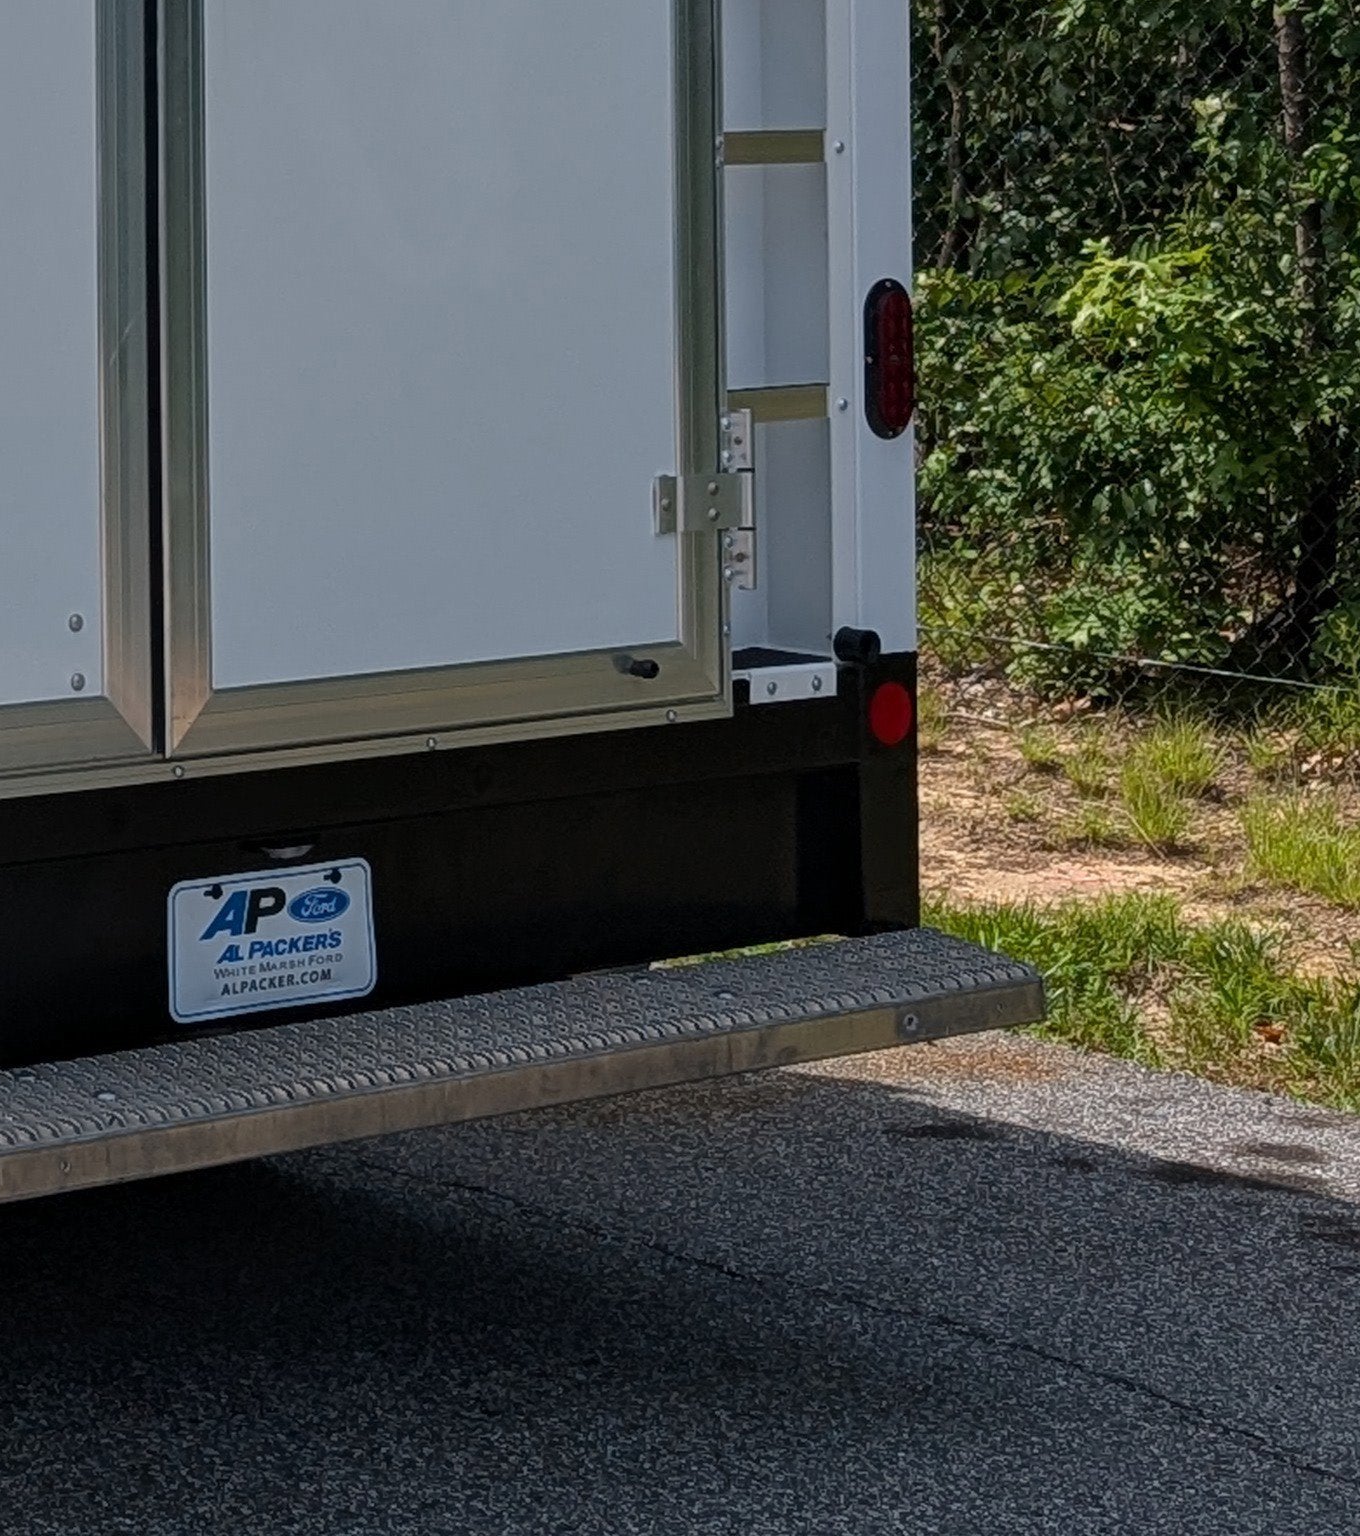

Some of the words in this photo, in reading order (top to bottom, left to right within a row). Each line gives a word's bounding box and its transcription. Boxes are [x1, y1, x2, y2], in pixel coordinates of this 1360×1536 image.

[198, 886, 286, 941] AP
[301, 893, 337, 917] Ford
[248, 928, 342, 960] PACKER'S
[213, 965, 257, 980] WHITE
[258, 959, 306, 973] MARSH
[307, 953, 344, 966] FORD
[220, 968, 332, 996] ALPACKER.COM
